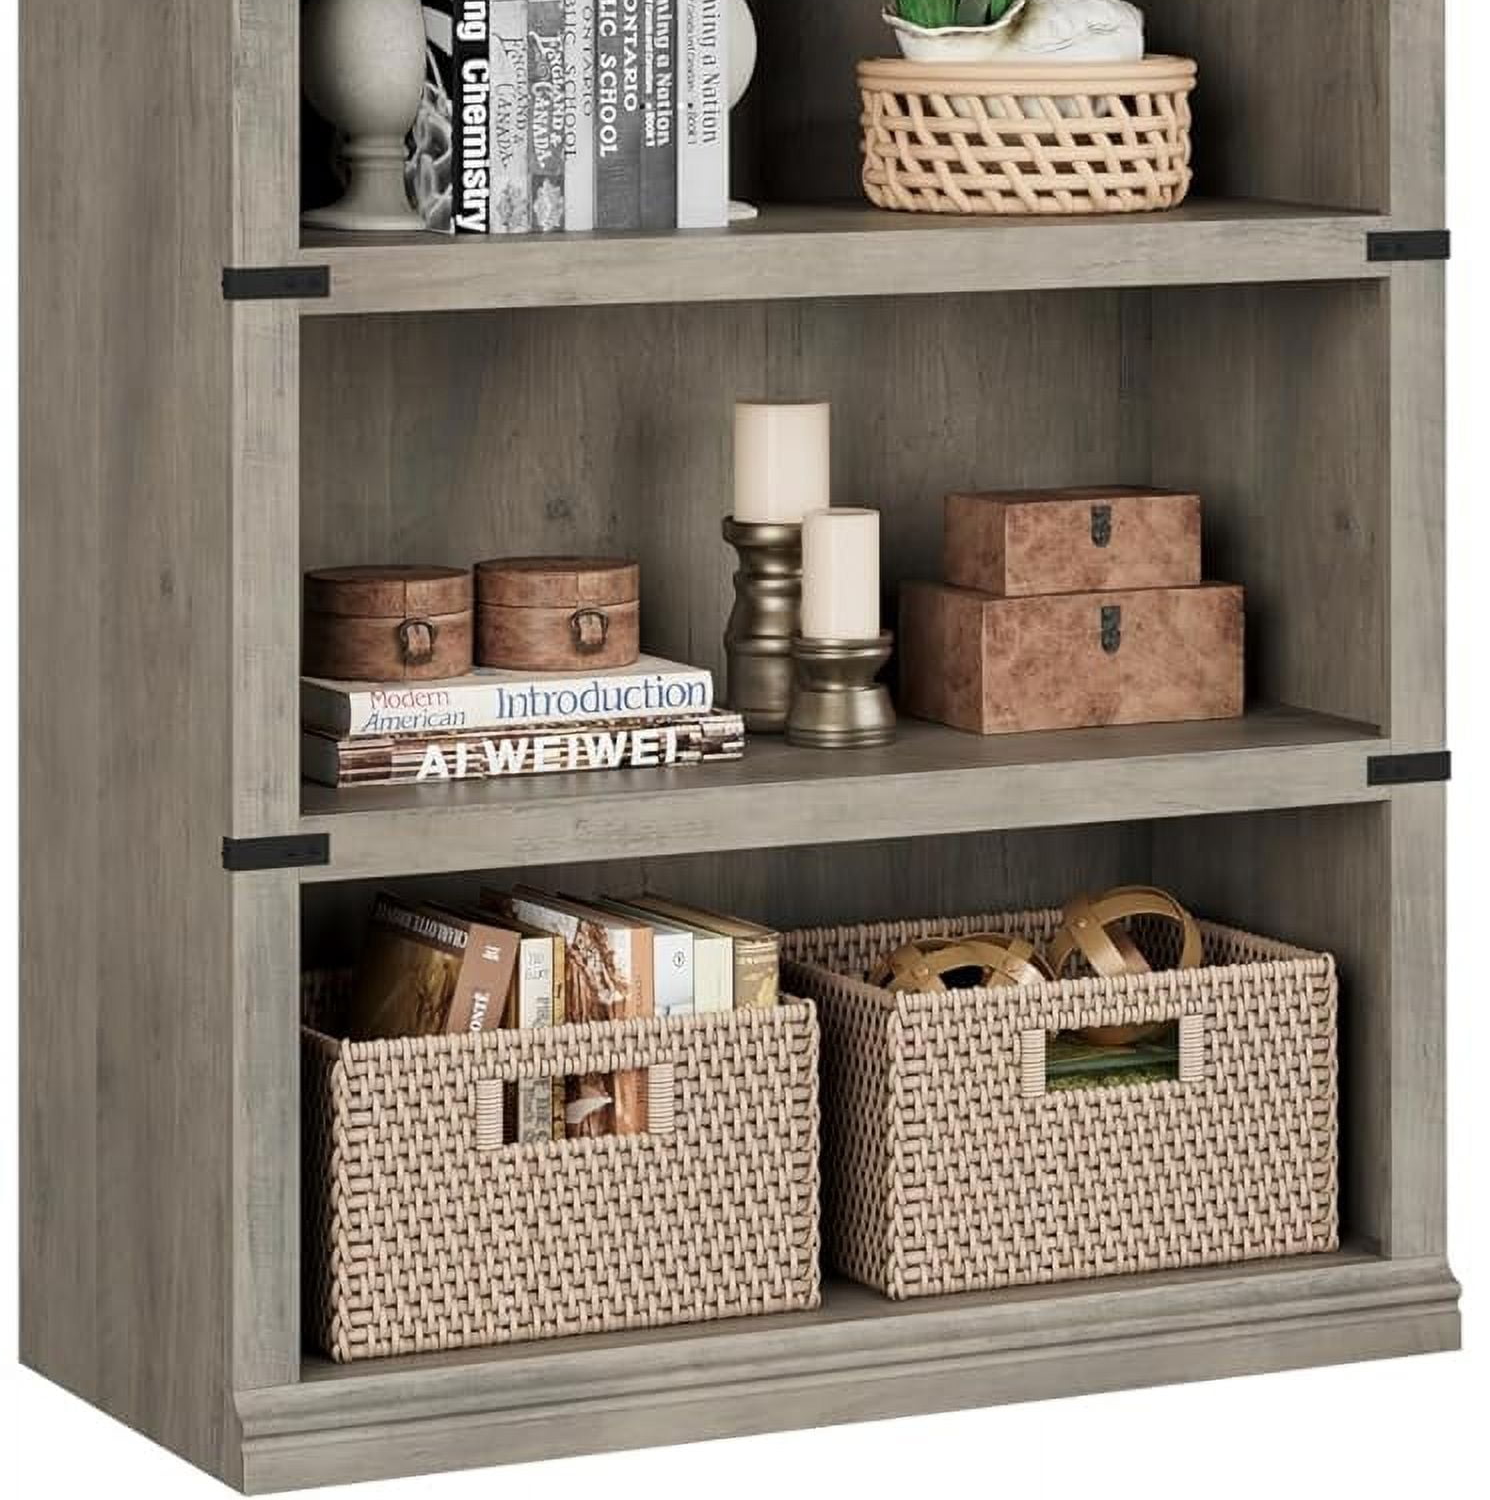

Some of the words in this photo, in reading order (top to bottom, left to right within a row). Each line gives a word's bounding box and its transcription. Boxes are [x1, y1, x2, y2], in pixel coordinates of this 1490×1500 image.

[582, 5, 593, 117] ONTARIO
[656, 54, 669, 68] a
[702, 54, 716, 65] a
[564, 65, 577, 161] SCHOOL
[599, 52, 618, 158] SCHOOL
[655, 73, 672, 147] Nation
[702, 73, 720, 144] Nation
[455, 57, 490, 233] Chemistry
[361, 707, 466, 731] American
[369, 689, 449, 709] Modern
[495, 674, 707, 719] Introduction
[415, 742, 470, 781] AI
[482, 728, 682, 775] WEIWEI
